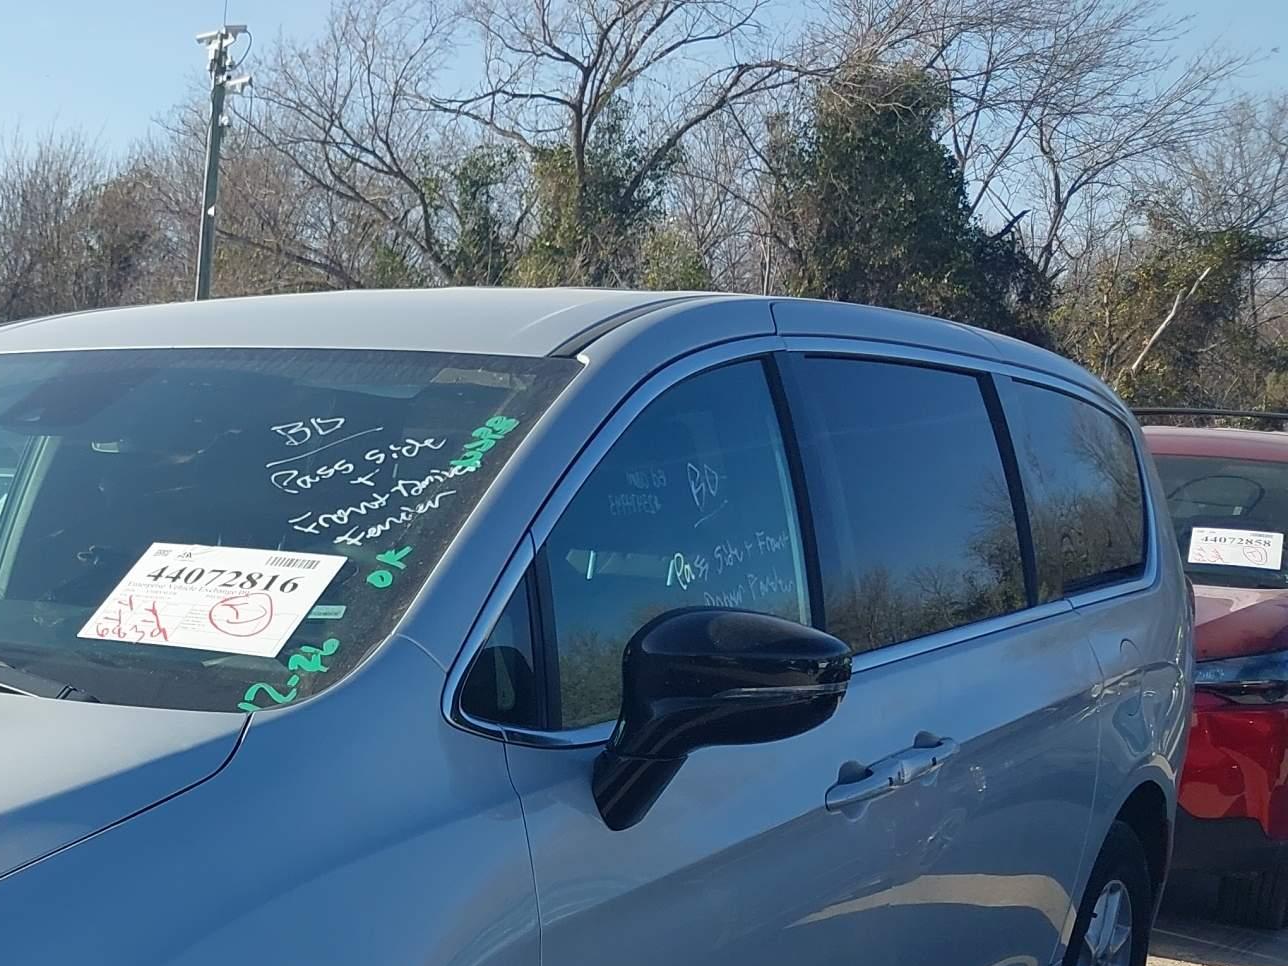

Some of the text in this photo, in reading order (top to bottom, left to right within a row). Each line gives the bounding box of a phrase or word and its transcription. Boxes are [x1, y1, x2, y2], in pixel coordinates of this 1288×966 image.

[1201, 535, 1272, 547] 44072858
[146, 565, 305, 594] 44072816
[366, 545, 414, 589] OK
